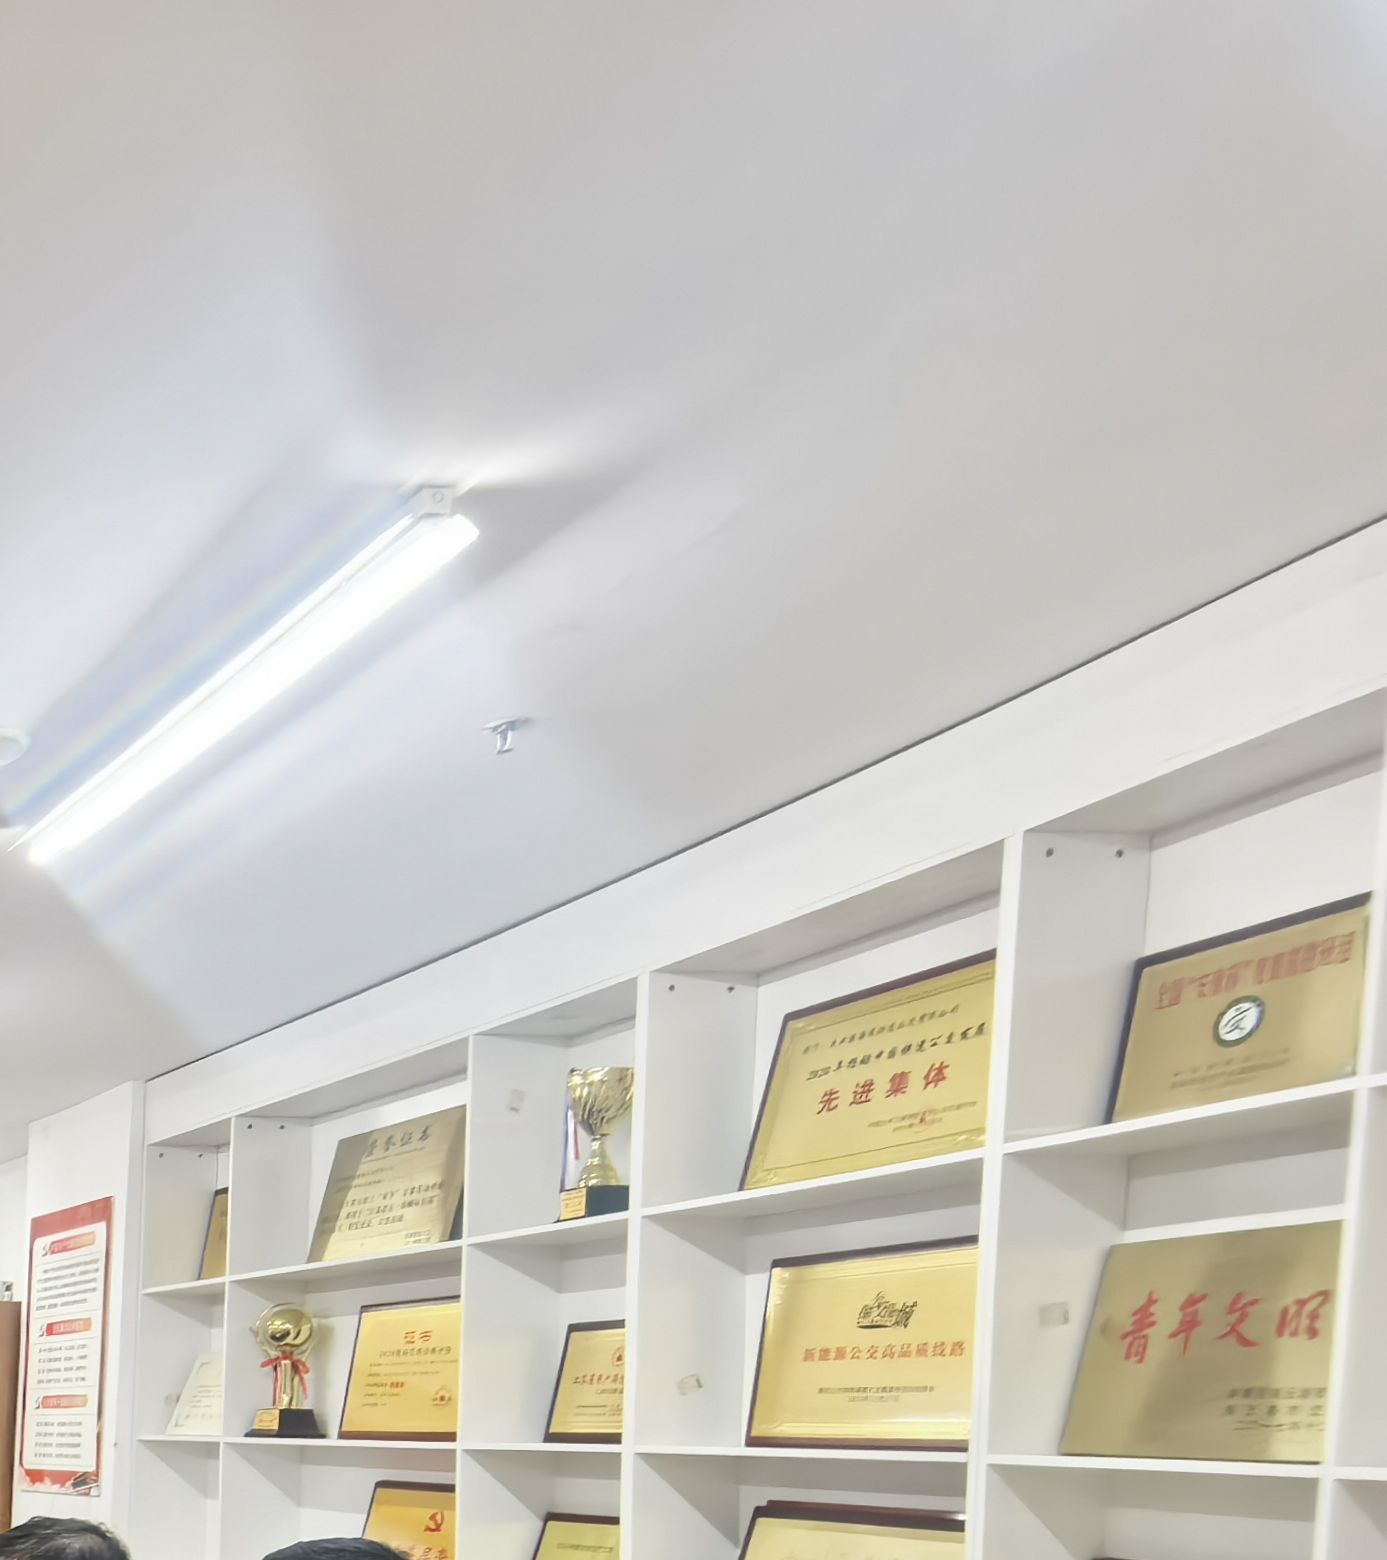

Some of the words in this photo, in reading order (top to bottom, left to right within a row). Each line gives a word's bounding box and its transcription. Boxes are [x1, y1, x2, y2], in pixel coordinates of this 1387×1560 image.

[816, 1060, 950, 1115] 先进集体
[1120, 1289, 1333, 1364] 青年文明
